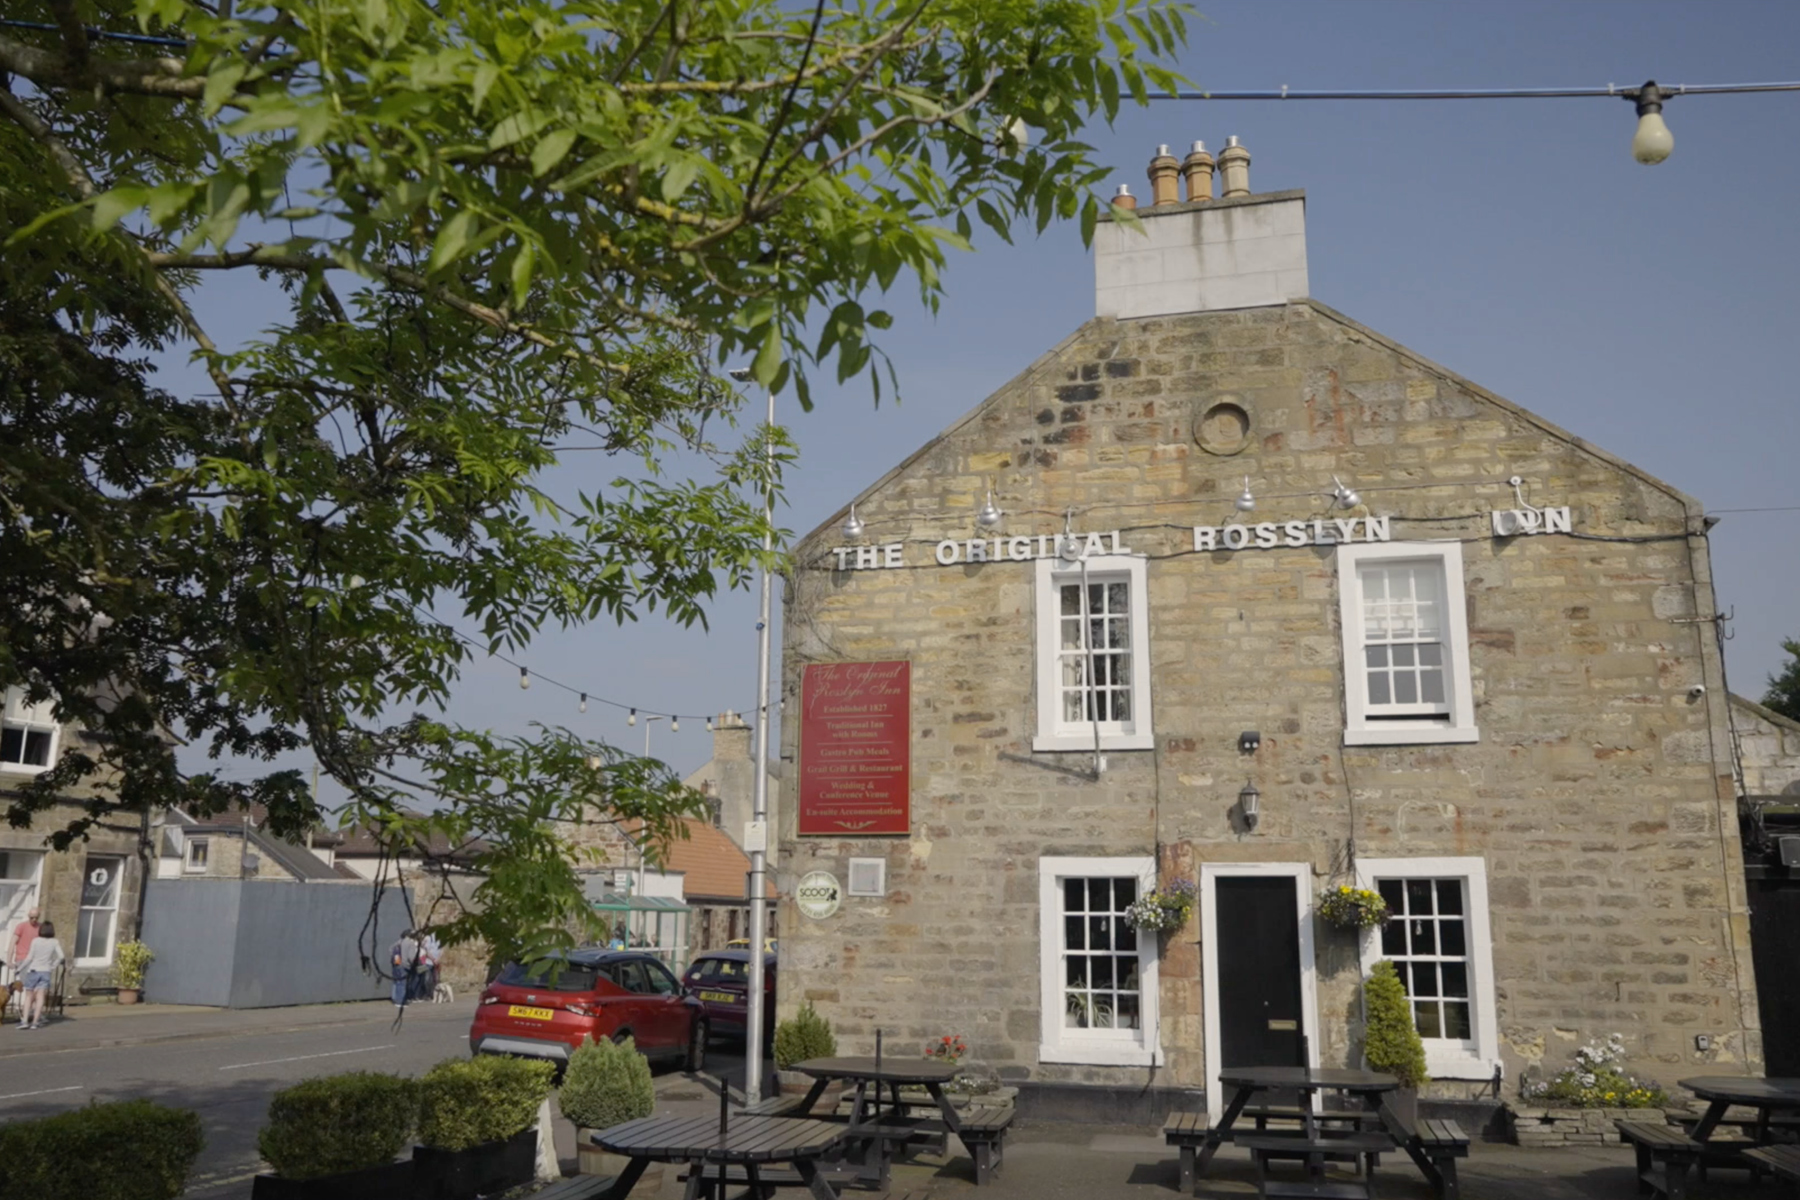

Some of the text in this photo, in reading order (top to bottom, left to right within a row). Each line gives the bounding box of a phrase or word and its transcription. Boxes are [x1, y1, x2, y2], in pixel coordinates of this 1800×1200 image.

[833, 544, 904, 570] THE
[1193, 516, 1390, 551] ROSSLYN
[813, 665, 902, 684] The Original
[869, 680, 901, 695] Inn
[823, 703, 887, 713] Established 1827
[826, 721, 869, 729] Traditional
[820, 747, 890, 757] Gastro Pub Meals
[807, 765, 828, 774] Grail
[829, 765, 848, 773] Grill
[859, 764, 903, 772] Restaurant
[830, 781, 875, 790] Wedding &
[819, 790, 890, 799] Conference Venue
[839, 806, 903, 815] Accommodation
